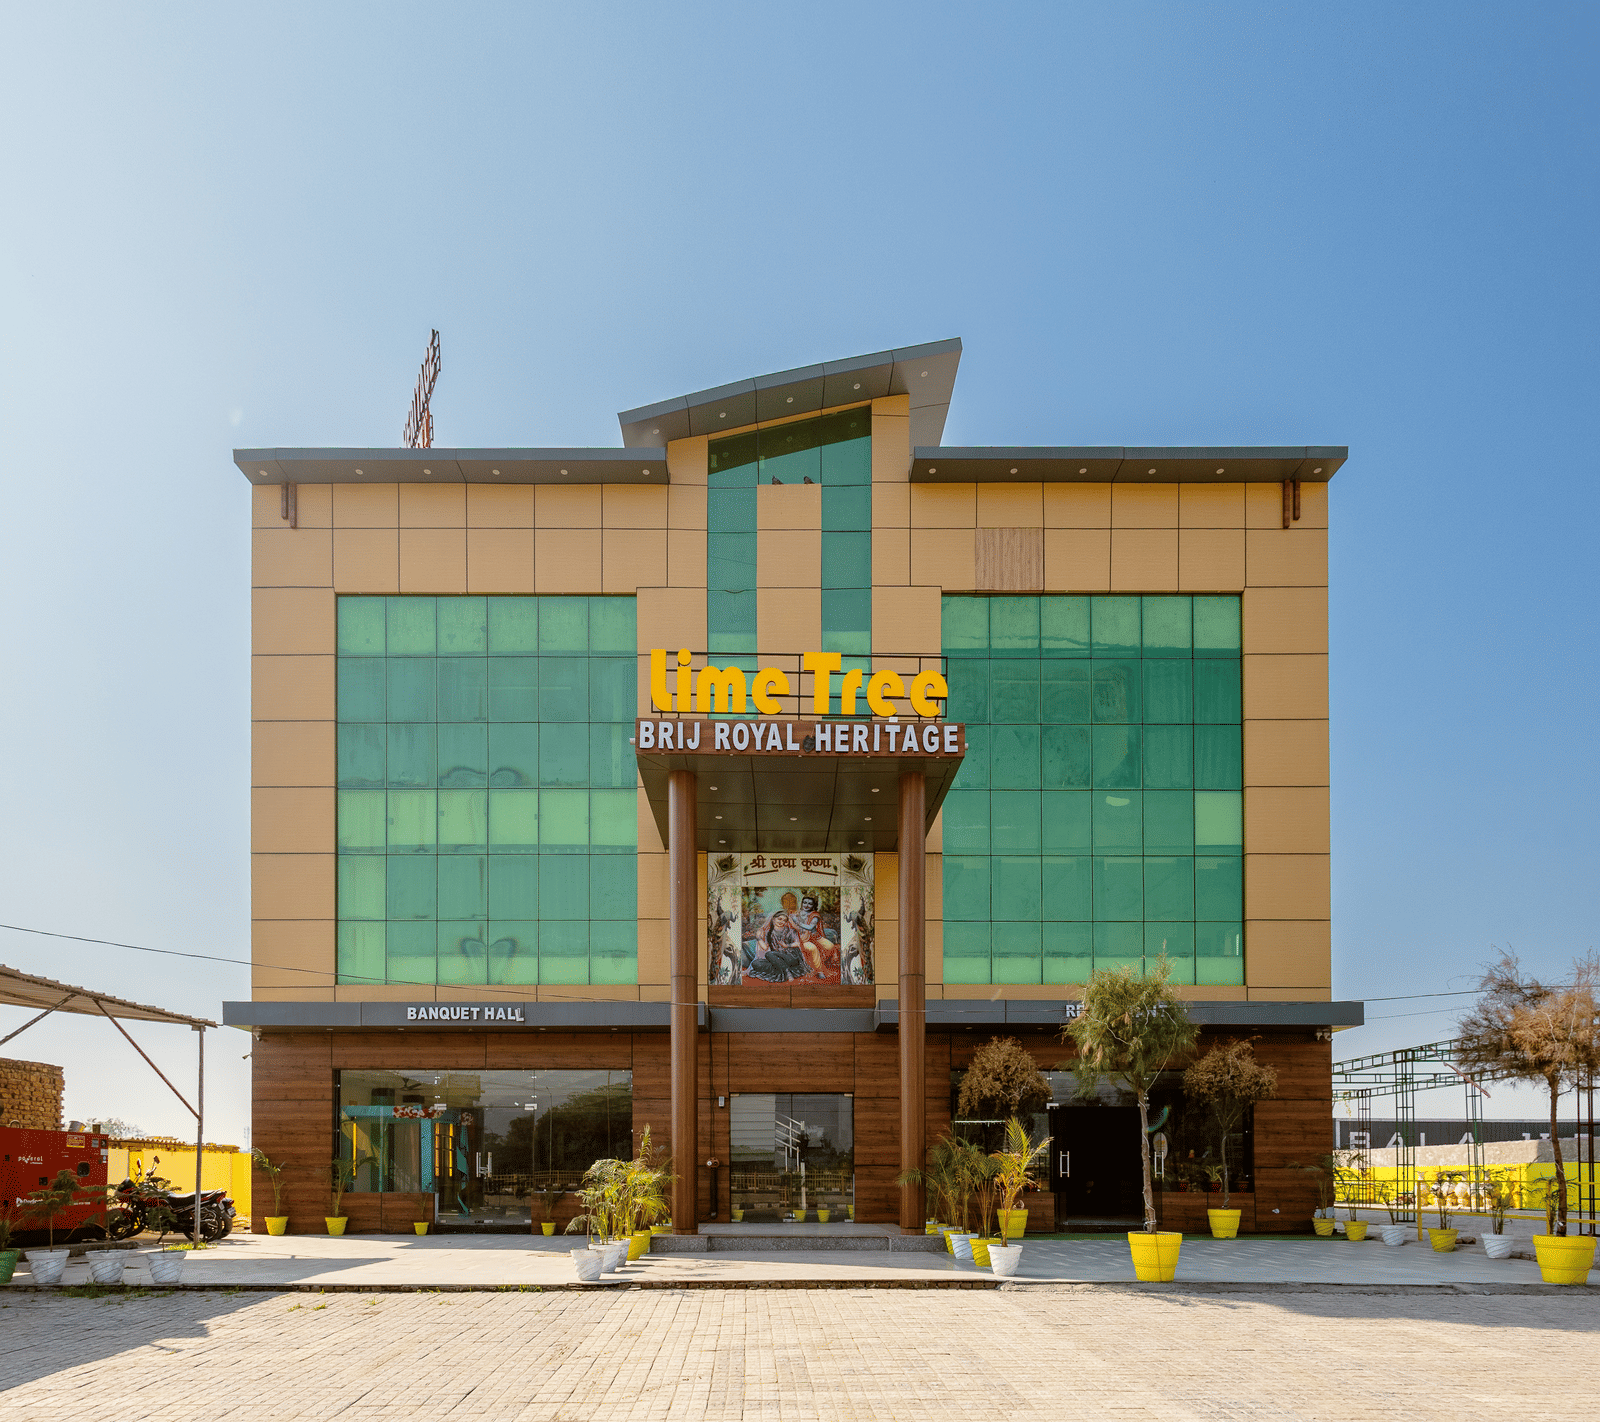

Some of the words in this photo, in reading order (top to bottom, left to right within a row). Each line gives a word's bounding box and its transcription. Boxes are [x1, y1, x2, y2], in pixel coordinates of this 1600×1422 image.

[803, 652, 949, 717] Tree
[639, 721, 701, 751] BRIJ
[714, 722, 800, 752] ROYAL
[814, 724, 960, 754] HERITAGE
[750, 854, 767, 869] श्री
[770, 858, 797, 869] राधा
[800, 857, 832, 870] कृष्णा
[407, 1006, 480, 1021] BANQUET
[484, 1007, 525, 1022] HALL
